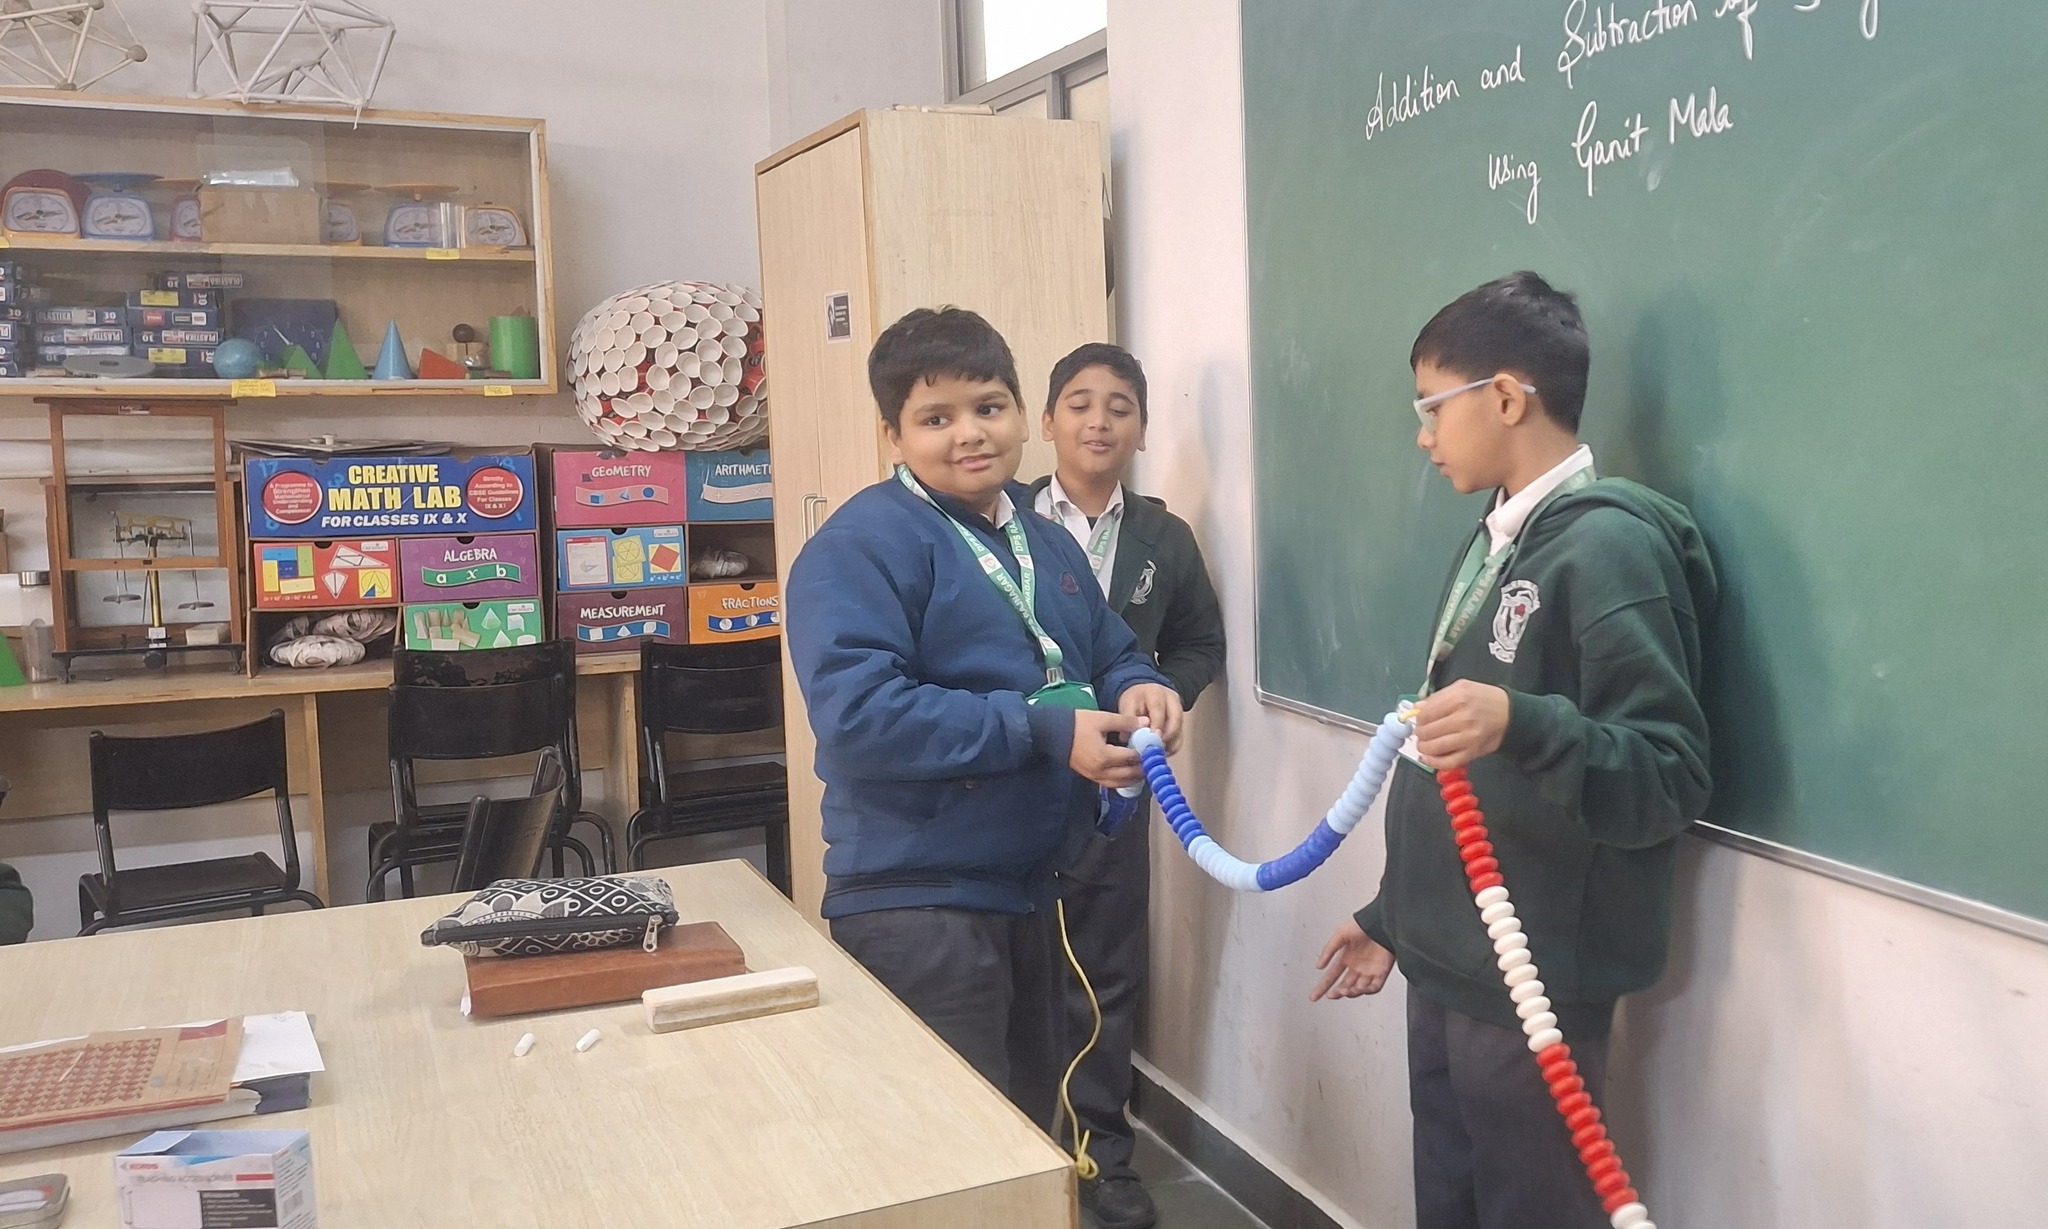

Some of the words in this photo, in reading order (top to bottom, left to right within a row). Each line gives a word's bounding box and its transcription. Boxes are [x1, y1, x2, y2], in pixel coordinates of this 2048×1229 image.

[1365, 64, 1461, 141] Addition
[1480, 43, 1526, 90] and
[1557, 0, 1698, 90] Subtraction
[1570, 100, 1650, 197] Ganit
[1668, 85, 1734, 145] Mala
[348, 464, 440, 485] CREATIVE
[591, 465, 652, 478] GEOMETRY
[327, 486, 402, 512] MATH
[412, 485, 462, 509] LAB
[321, 516, 351, 528] FOR
[351, 514, 419, 527] CLASSES
[423, 513, 439, 525] IX
[441, 513, 453, 524] &
[456, 512, 467, 524] X
[1013, 535, 1024, 552] DPS
[443, 547, 498, 562] ALGEBRA
[436, 573, 447, 583] a
[466, 568, 478, 580] x
[496, 564, 507, 578] b
[722, 595, 779, 609] FRACTIONS
[580, 603, 666, 619] MEASUREMENT
